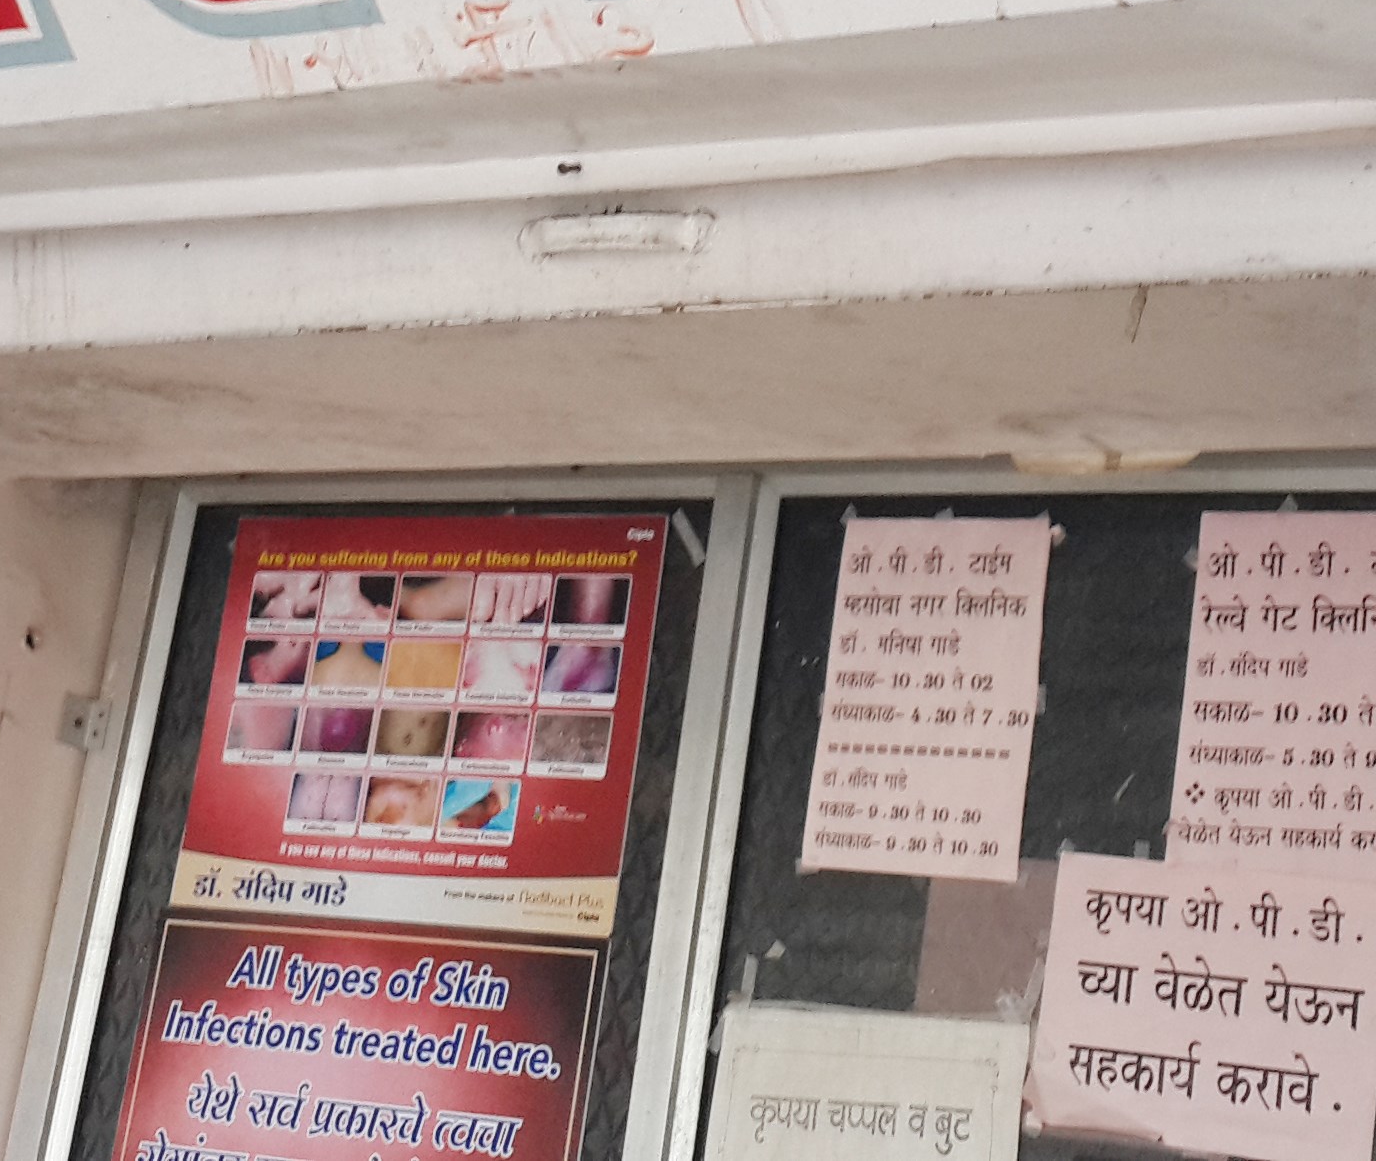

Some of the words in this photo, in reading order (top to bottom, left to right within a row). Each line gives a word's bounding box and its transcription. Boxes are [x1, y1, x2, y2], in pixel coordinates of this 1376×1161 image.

[258, 550, 284, 566] Are
[289, 551, 316, 570] you
[320, 550, 388, 569] suffering
[392, 550, 428, 566] from
[432, 552, 462, 571] any
[465, 550, 482, 567] of
[486, 550, 530, 567] these
[969, 544, 1014, 575] टाईम
[910, 594, 948, 618] नगर
[1201, 594, 1250, 635] रेल्वे
[1260, 594, 1302, 633] गेट
[971, 673, 994, 691] 02
[1278, 651, 1310, 680] गाडे
[1358, 694, 1376, 727] ते
[1343, 742, 1356, 770] ते
[1214, 786, 1261, 815] कृपया
[288, 842, 304, 859] you
[304, 844, 319, 858] see
[320, 844, 337, 861] any
[337, 845, 346, 860] of
[347, 845, 371, 861] these
[423, 850, 456, 867] consult
[455, 853, 477, 870] your
[193, 866, 223, 899] डॉ.
[233, 867, 295, 904] संदिप
[302, 874, 348, 907] गाडे
[1085, 888, 1169, 935] कृपया
[226, 946, 281, 988] All
[286, 954, 380, 1005] types
[387, 957, 432, 1002] of
[430, 961, 510, 1010] Skin
[1077, 959, 1139, 1005] च्या
[1153, 950, 1249, 1018] वेळेत
[1264, 962, 1366, 1031] येऊन
[161, 999, 325, 1054] Infections
[332, 1018, 466, 1069] treated
[467, 1029, 563, 1080] here.
[1068, 1039, 1201, 1100] सहकार्य
[186, 1072, 239, 1124] येथे
[245, 1081, 312, 1131] सर्व
[307, 1093, 426, 1144] प्रकारचे
[433, 1109, 524, 1157] त्वचा
[750, 1094, 821, 1144] कृपया
[827, 1097, 901, 1137] चप्पल
[908, 1100, 929, 1138] व
[935, 1104, 974, 1156] बुट
